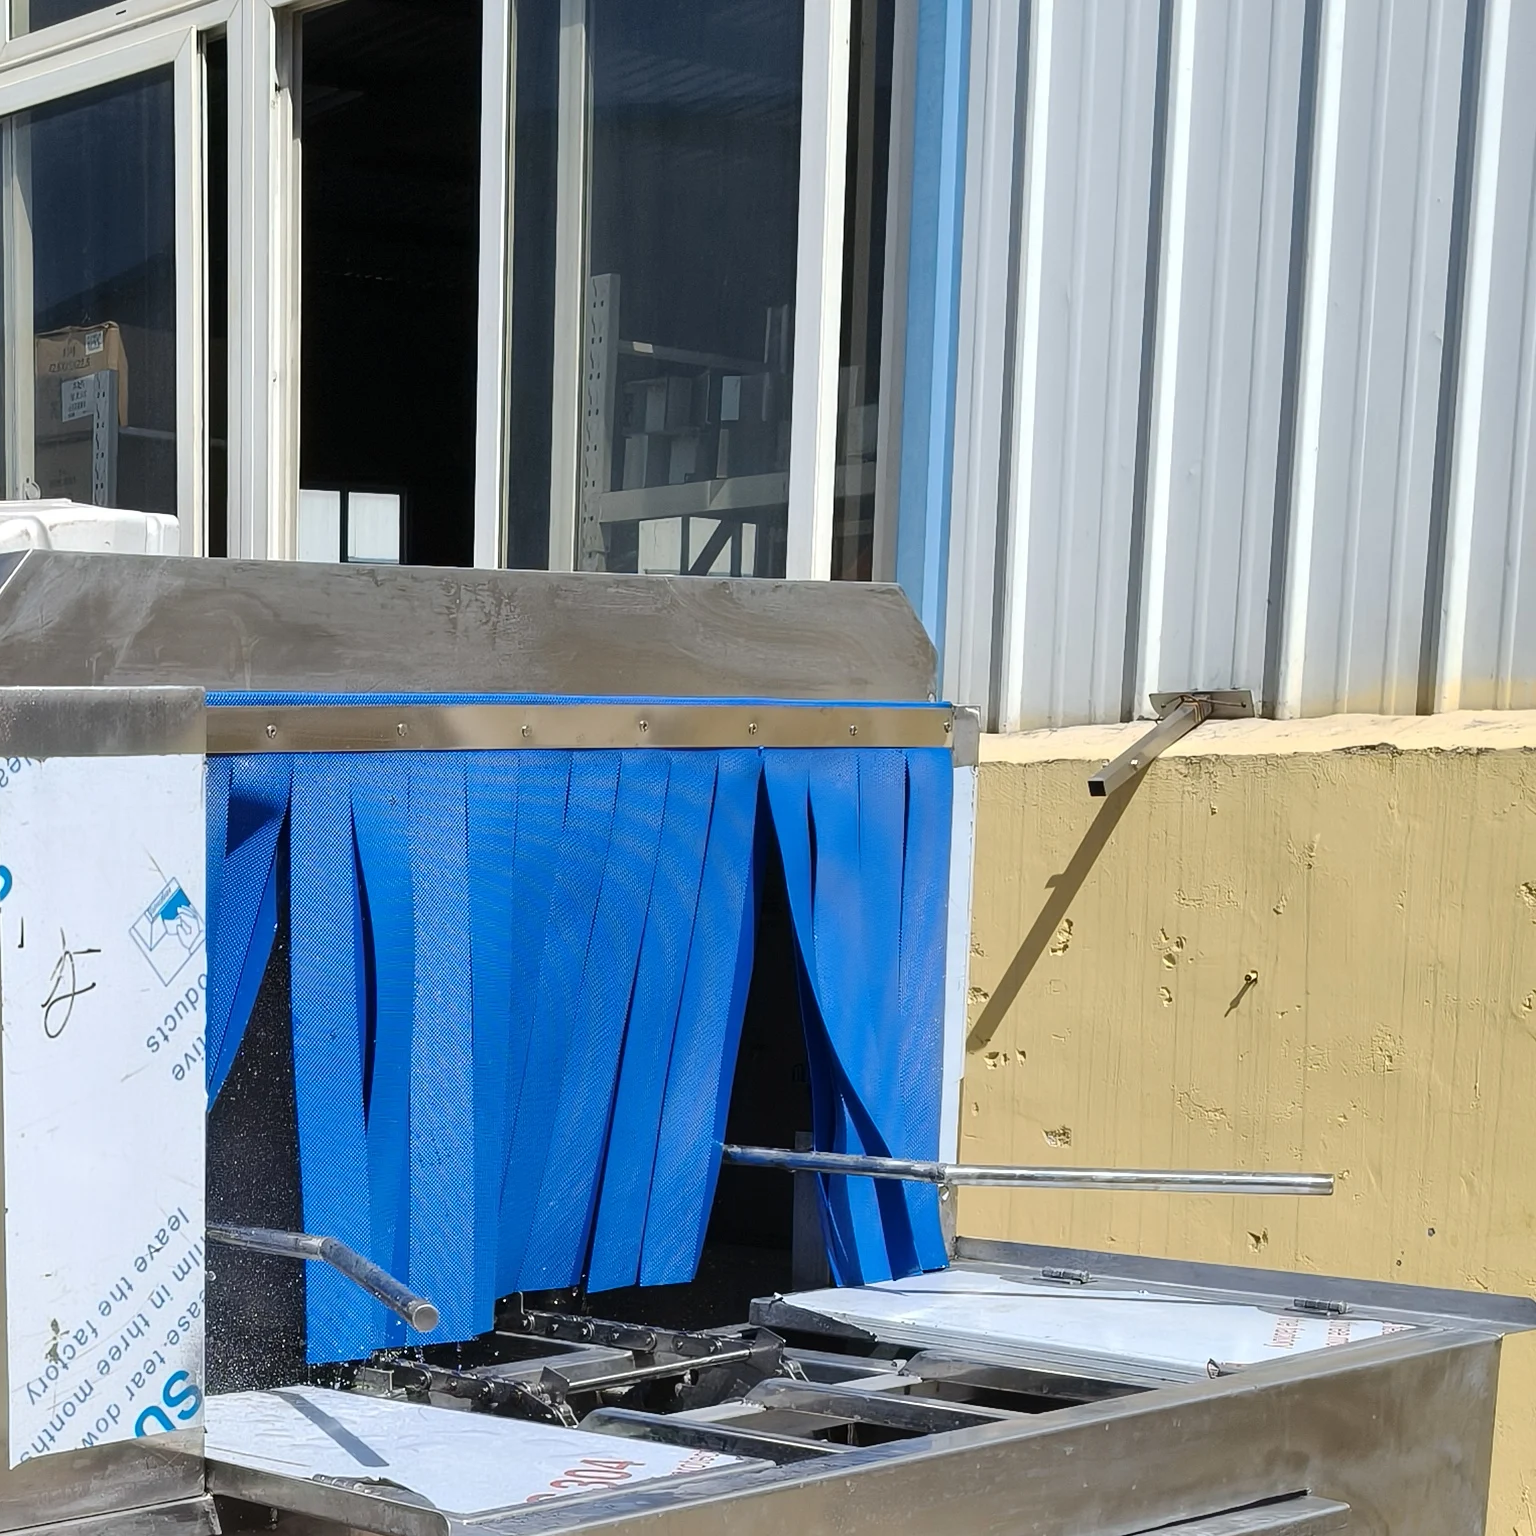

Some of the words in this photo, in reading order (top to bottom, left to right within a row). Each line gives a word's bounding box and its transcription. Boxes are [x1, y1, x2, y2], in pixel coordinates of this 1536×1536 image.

[134, 1207, 190, 1274] leave
[98, 1276, 134, 1317] the
[150, 1284, 174, 1310] in
[26, 1319, 99, 1405] factory
[97, 1313, 151, 1376] three
[125, 1350, 166, 1402] tear
[76, 1403, 121, 1450] dow
